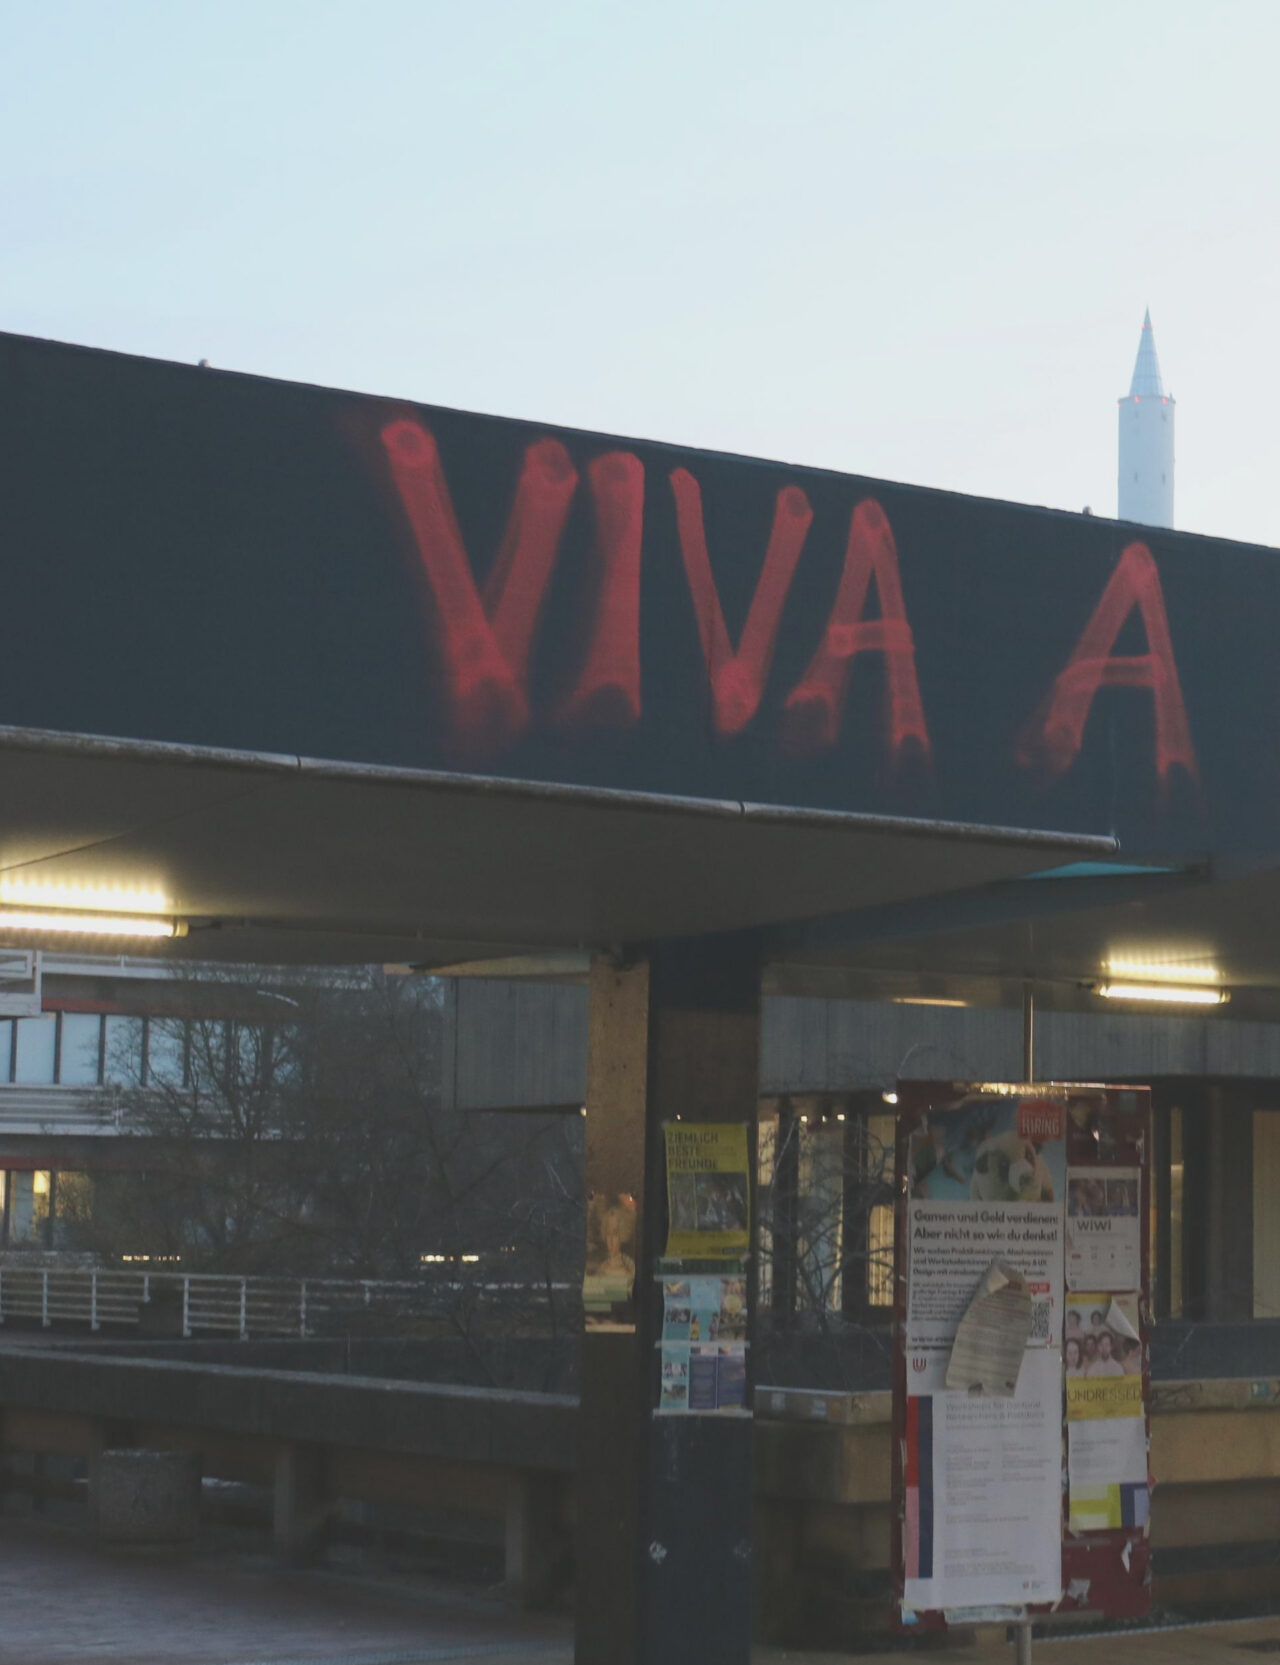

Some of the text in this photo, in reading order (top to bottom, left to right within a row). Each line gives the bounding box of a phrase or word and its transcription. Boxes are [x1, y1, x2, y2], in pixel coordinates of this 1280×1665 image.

[381, 418, 930, 757] VIVA
[1017, 540, 1196, 788] A
[1022, 1118, 1060, 1137] HIRING
[668, 1131, 719, 1144] ZIEMLICH
[668, 1146, 701, 1157] BESTE
[668, 1159, 719, 1169] FREUNDE
[914, 1209, 955, 1222] Gamen
[957, 1211, 978, 1222] und
[980, 1210, 1005, 1223] Geld
[914, 1227, 941, 1240] Aber
[944, 1228, 970, 1240] nicht
[973, 1230, 984, 1240] so
[987, 1229, 1005, 1240] wie
[1007, 1229, 1021, 1240] du
